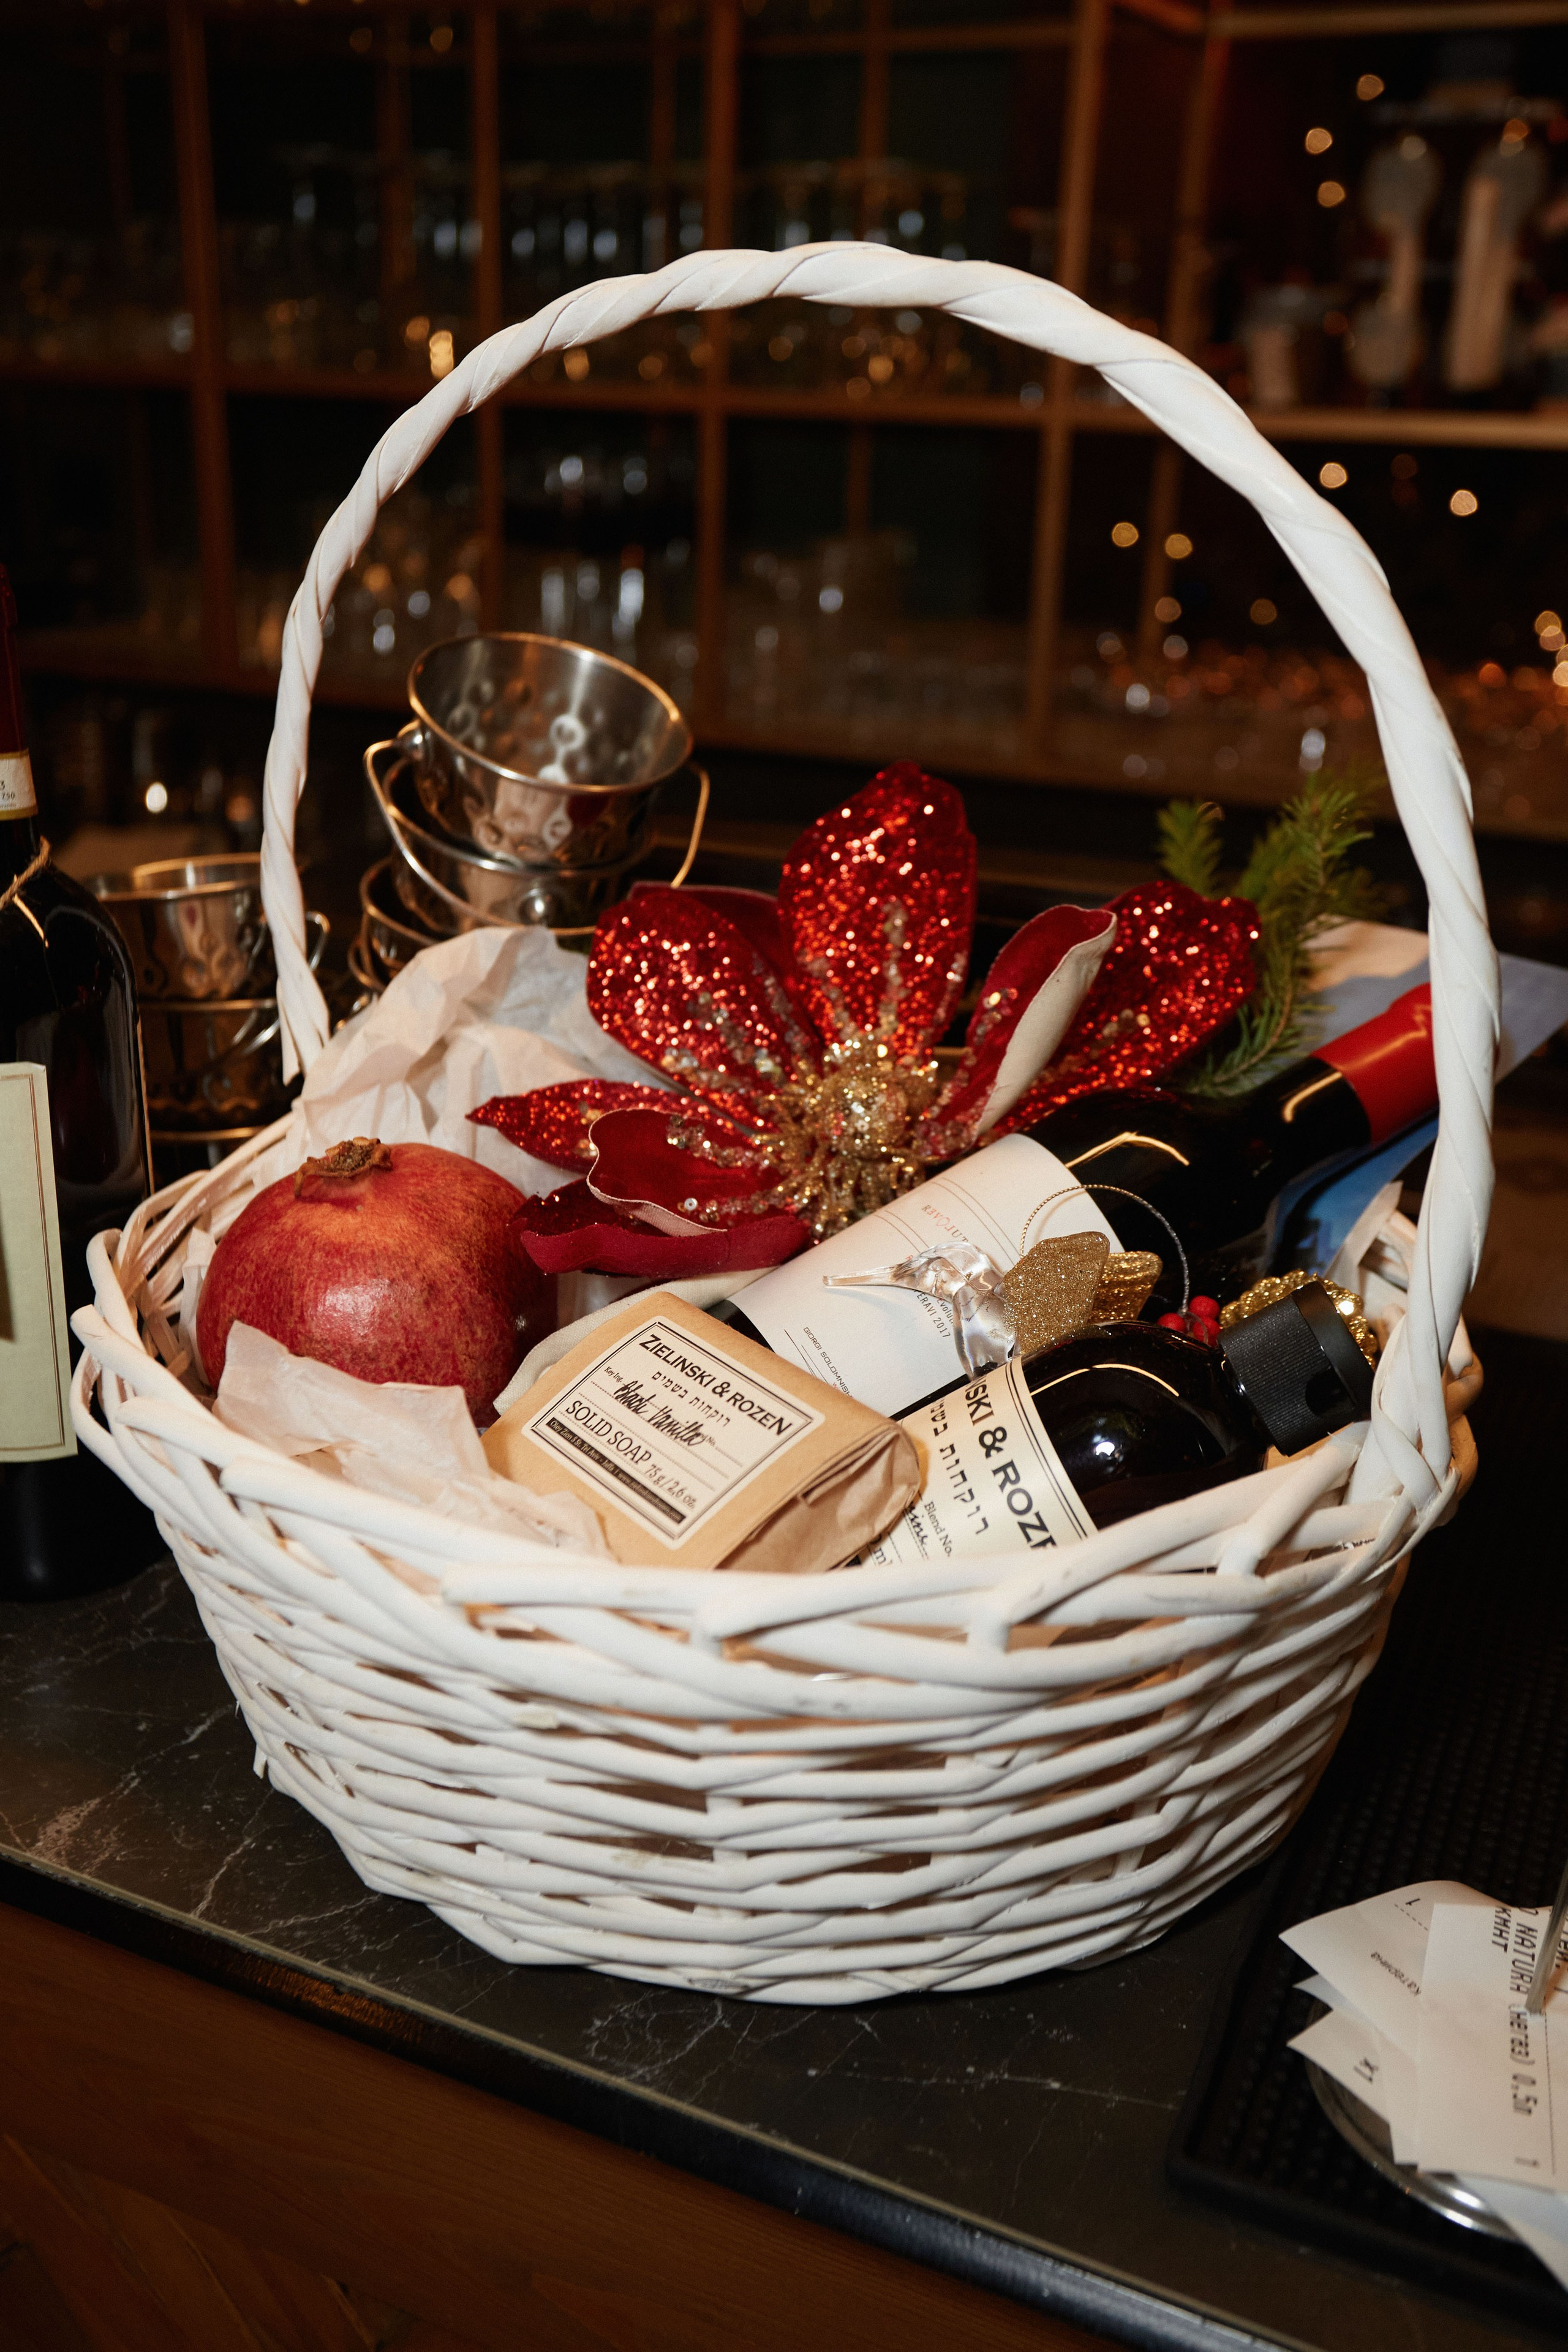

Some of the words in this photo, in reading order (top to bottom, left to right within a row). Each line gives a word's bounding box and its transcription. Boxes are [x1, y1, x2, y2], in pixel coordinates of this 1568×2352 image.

[803, 1327, 823, 1351] GIORGI
[933, 1317, 951, 1338] 2017
[604, 1366, 616, 1378] Key
[613, 1373, 623, 1382] Ing.
[639, 1334, 717, 1388] ZIELINSKI
[712, 1382, 731, 1398] &
[726, 1392, 793, 1436] ROZEN
[651, 1371, 688, 1398] בשמים
[647, 1406, 706, 1446] Vanilla
[689, 1396, 731, 1428] רוקחות
[565, 1400, 612, 1437] SOLID
[608, 1431, 652, 1464] SOAP
[978, 1427, 1008, 1459] &
[940, 1444, 989, 1535] רוקחות
[924, 1501, 945, 1535] Blend
[940, 1535, 953, 1557] No.
[1509, 1922, 1539, 1995] NATURA
